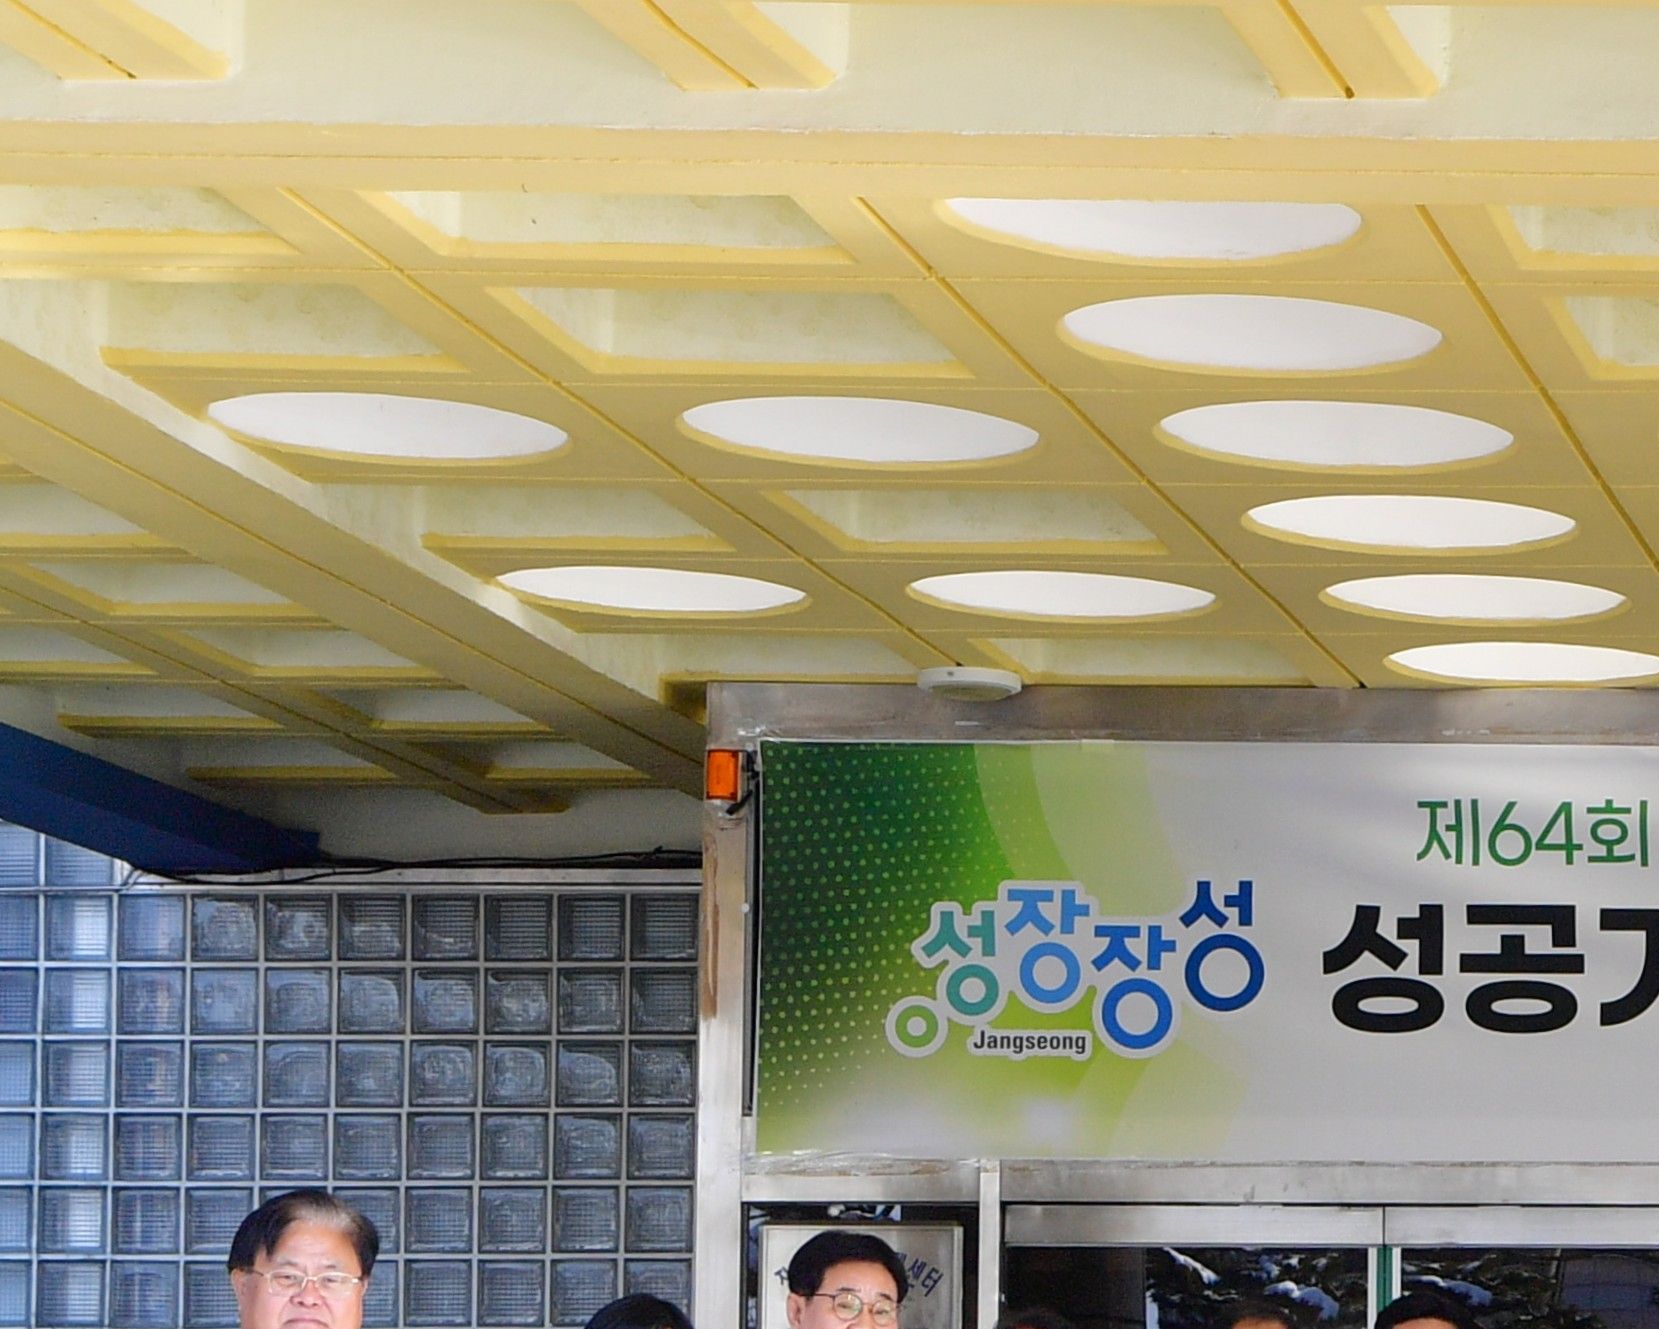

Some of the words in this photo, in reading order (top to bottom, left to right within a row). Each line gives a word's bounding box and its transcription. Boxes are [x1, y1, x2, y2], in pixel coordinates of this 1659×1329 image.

[1416, 798, 1649, 868] 제64회
[895, 879, 1266, 1050] 성장장성
[972, 1029, 1087, 1055] Jangseong
